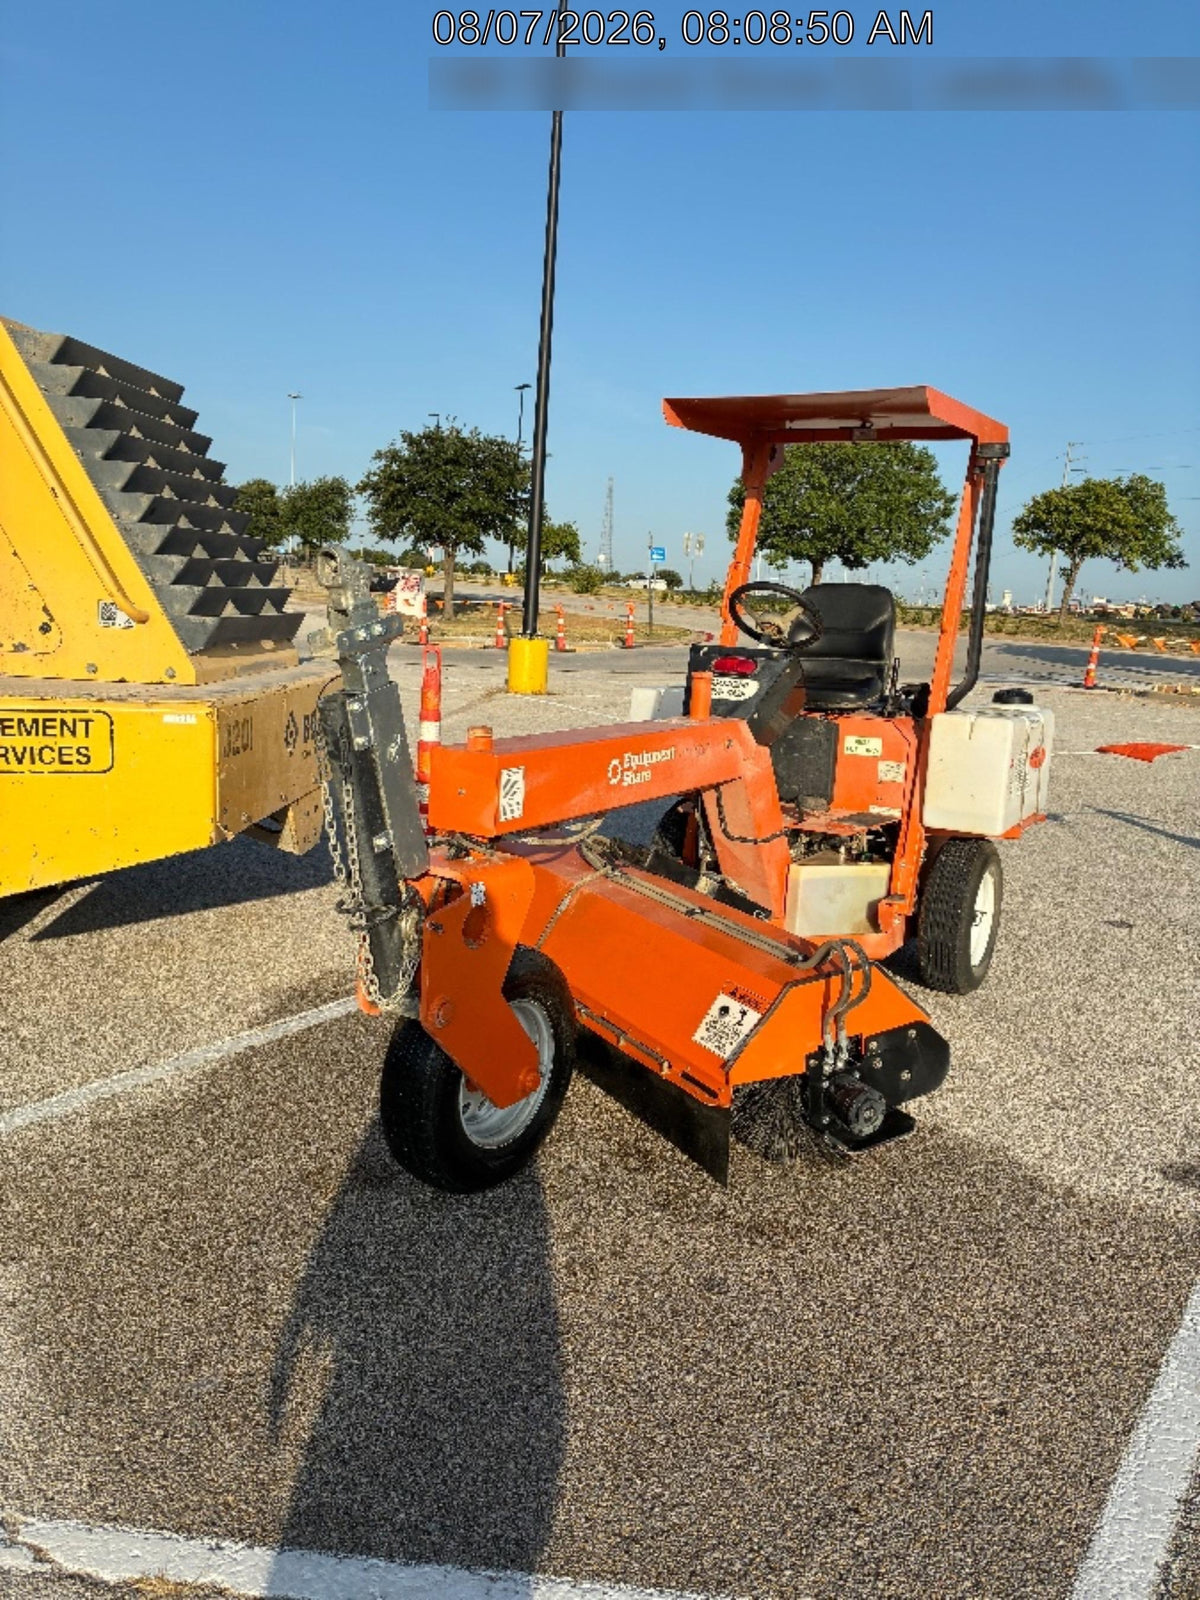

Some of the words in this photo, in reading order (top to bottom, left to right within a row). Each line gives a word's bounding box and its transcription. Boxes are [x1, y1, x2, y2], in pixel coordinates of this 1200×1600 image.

[223, 716, 253, 758] 3201
[623, 746, 675, 769] Equipment
[622, 770, 651, 786] Share
